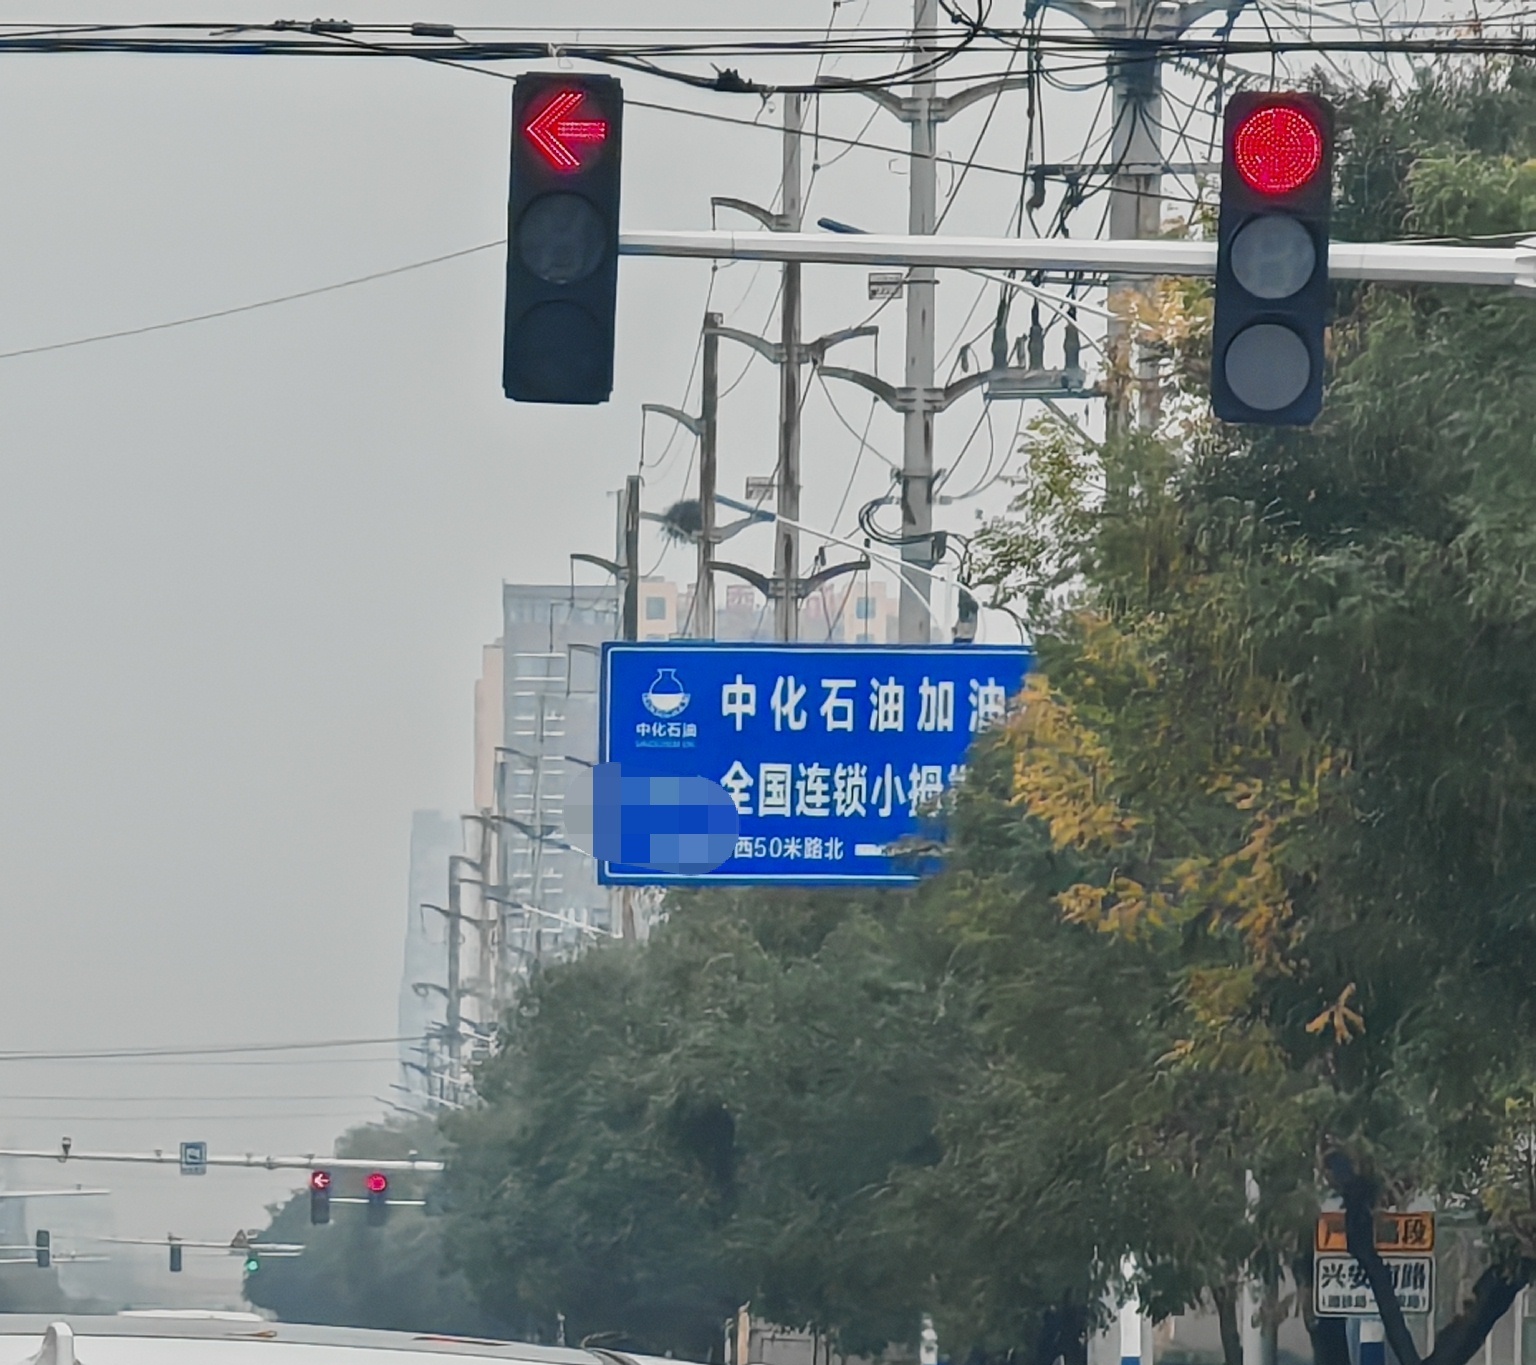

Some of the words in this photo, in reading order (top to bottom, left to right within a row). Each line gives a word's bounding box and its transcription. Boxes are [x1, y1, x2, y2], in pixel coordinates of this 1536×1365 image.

[721, 674, 1005, 732] 中化石油加油
[636, 722, 697, 738] 中化石油
[720, 760, 969, 818] 全国连锁小拇
[734, 836, 844, 861] 西50米路北
